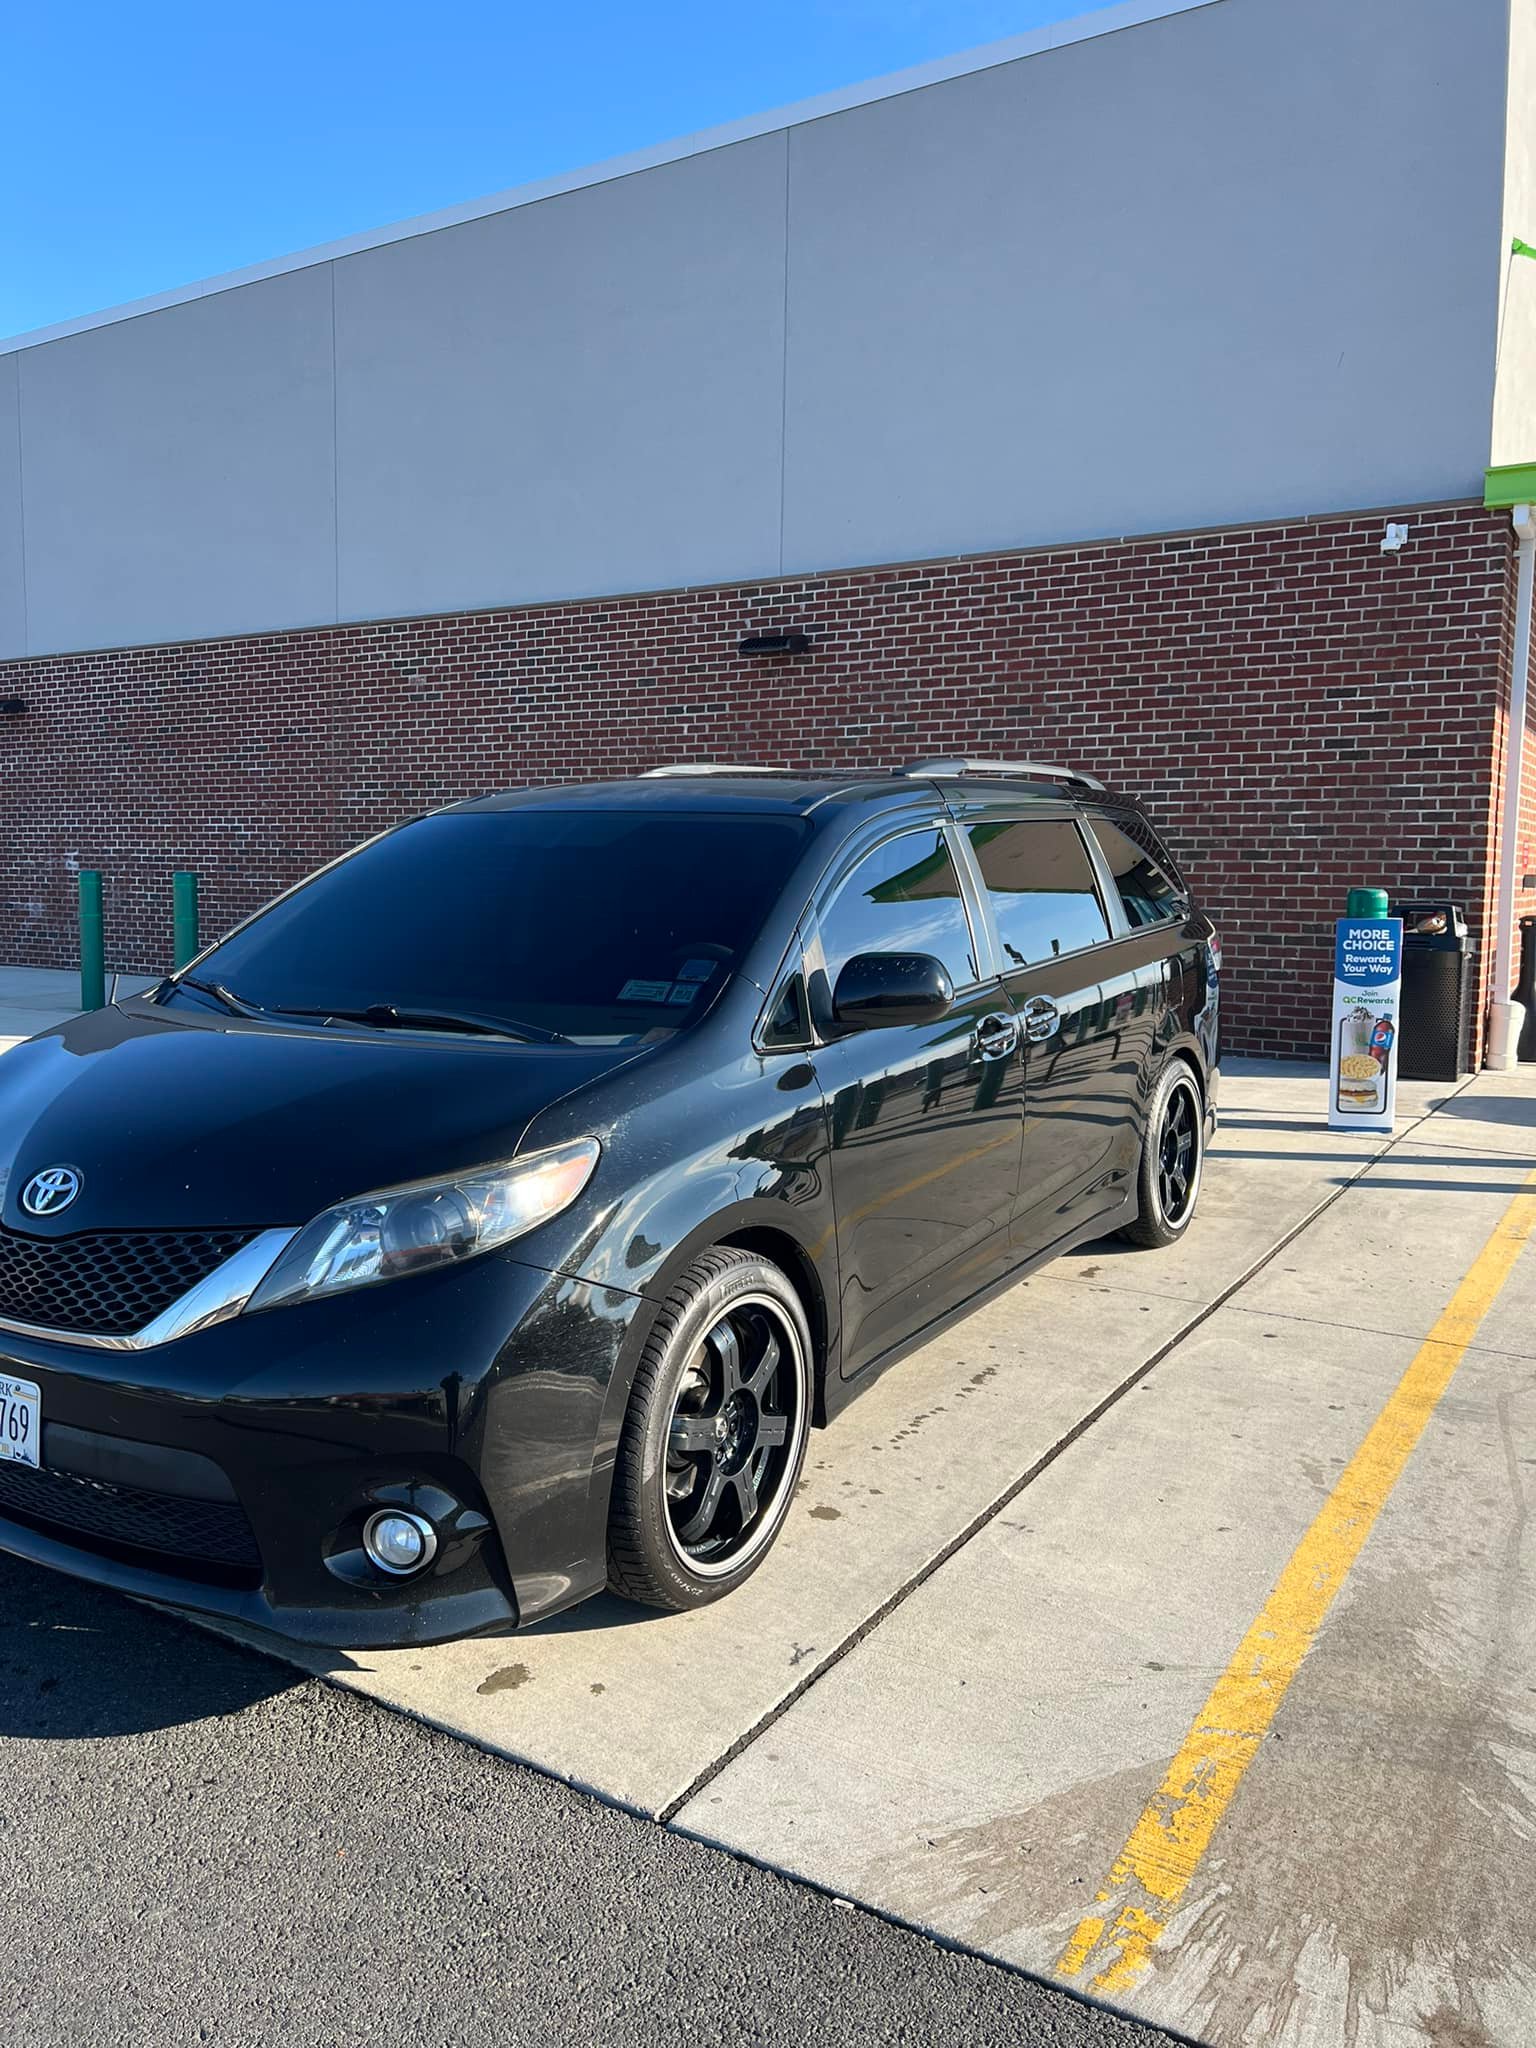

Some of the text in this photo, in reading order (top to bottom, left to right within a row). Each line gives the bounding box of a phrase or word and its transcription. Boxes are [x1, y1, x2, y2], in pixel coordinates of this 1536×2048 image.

[1349, 929, 1390, 939] MORE
[1343, 940, 1395, 950] CHOICE
[1345, 954, 1391, 963] Rewards
[1342, 964, 1393, 975] Your Way
[0, 1398, 29, 1444] 769
